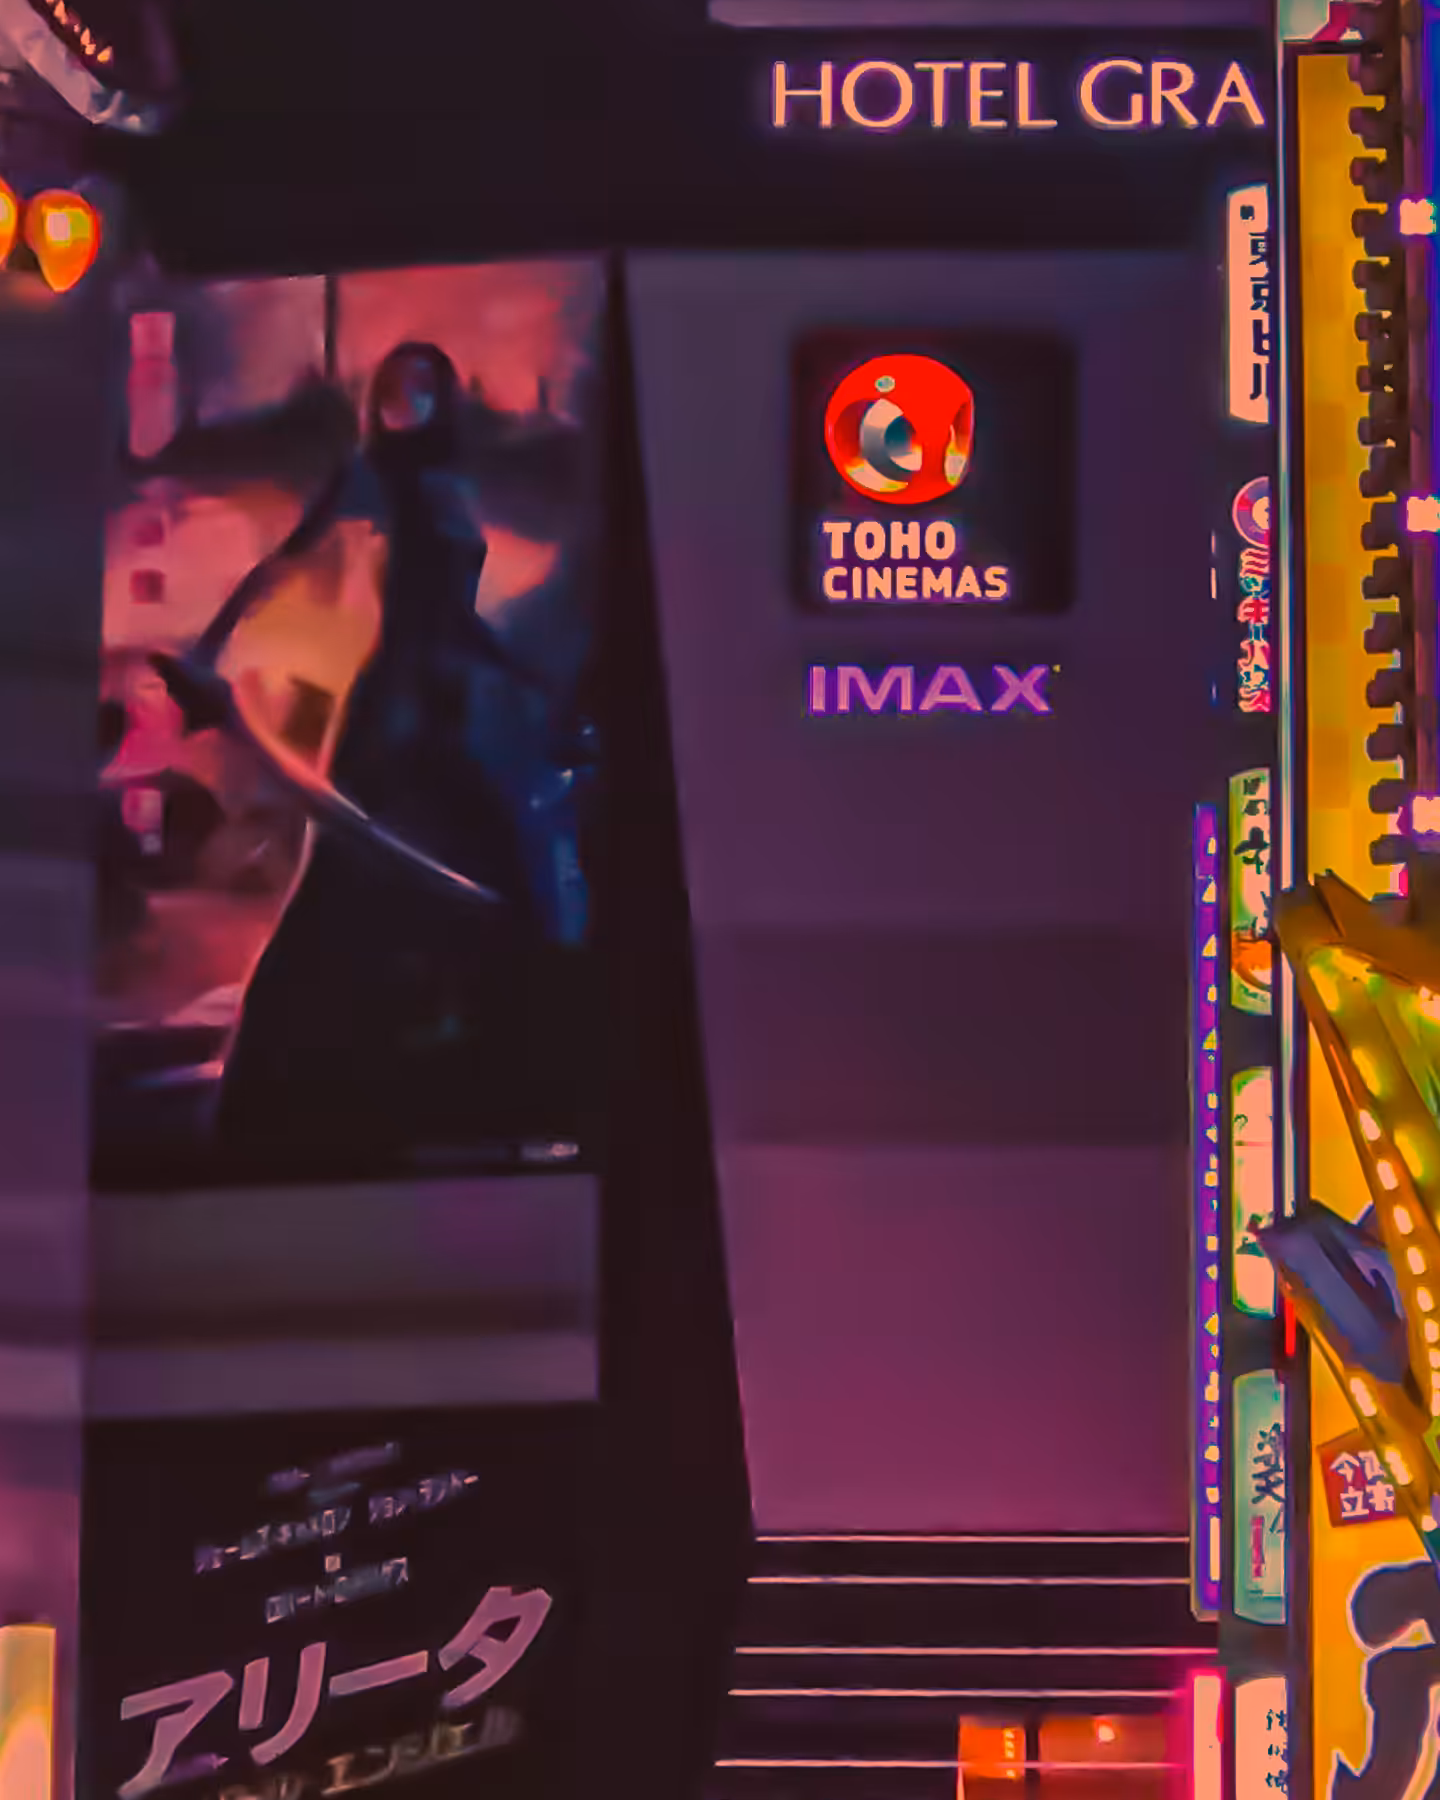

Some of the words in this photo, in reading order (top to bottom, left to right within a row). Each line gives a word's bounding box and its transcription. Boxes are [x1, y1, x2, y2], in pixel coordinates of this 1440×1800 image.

[772, 60, 1058, 130] HOTEL
[1079, 59, 1266, 130] GRA
[822, 521, 957, 561] TOHO
[822, 566, 1009, 601] CINEMAS
[808, 665, 1052, 713] IMAX
